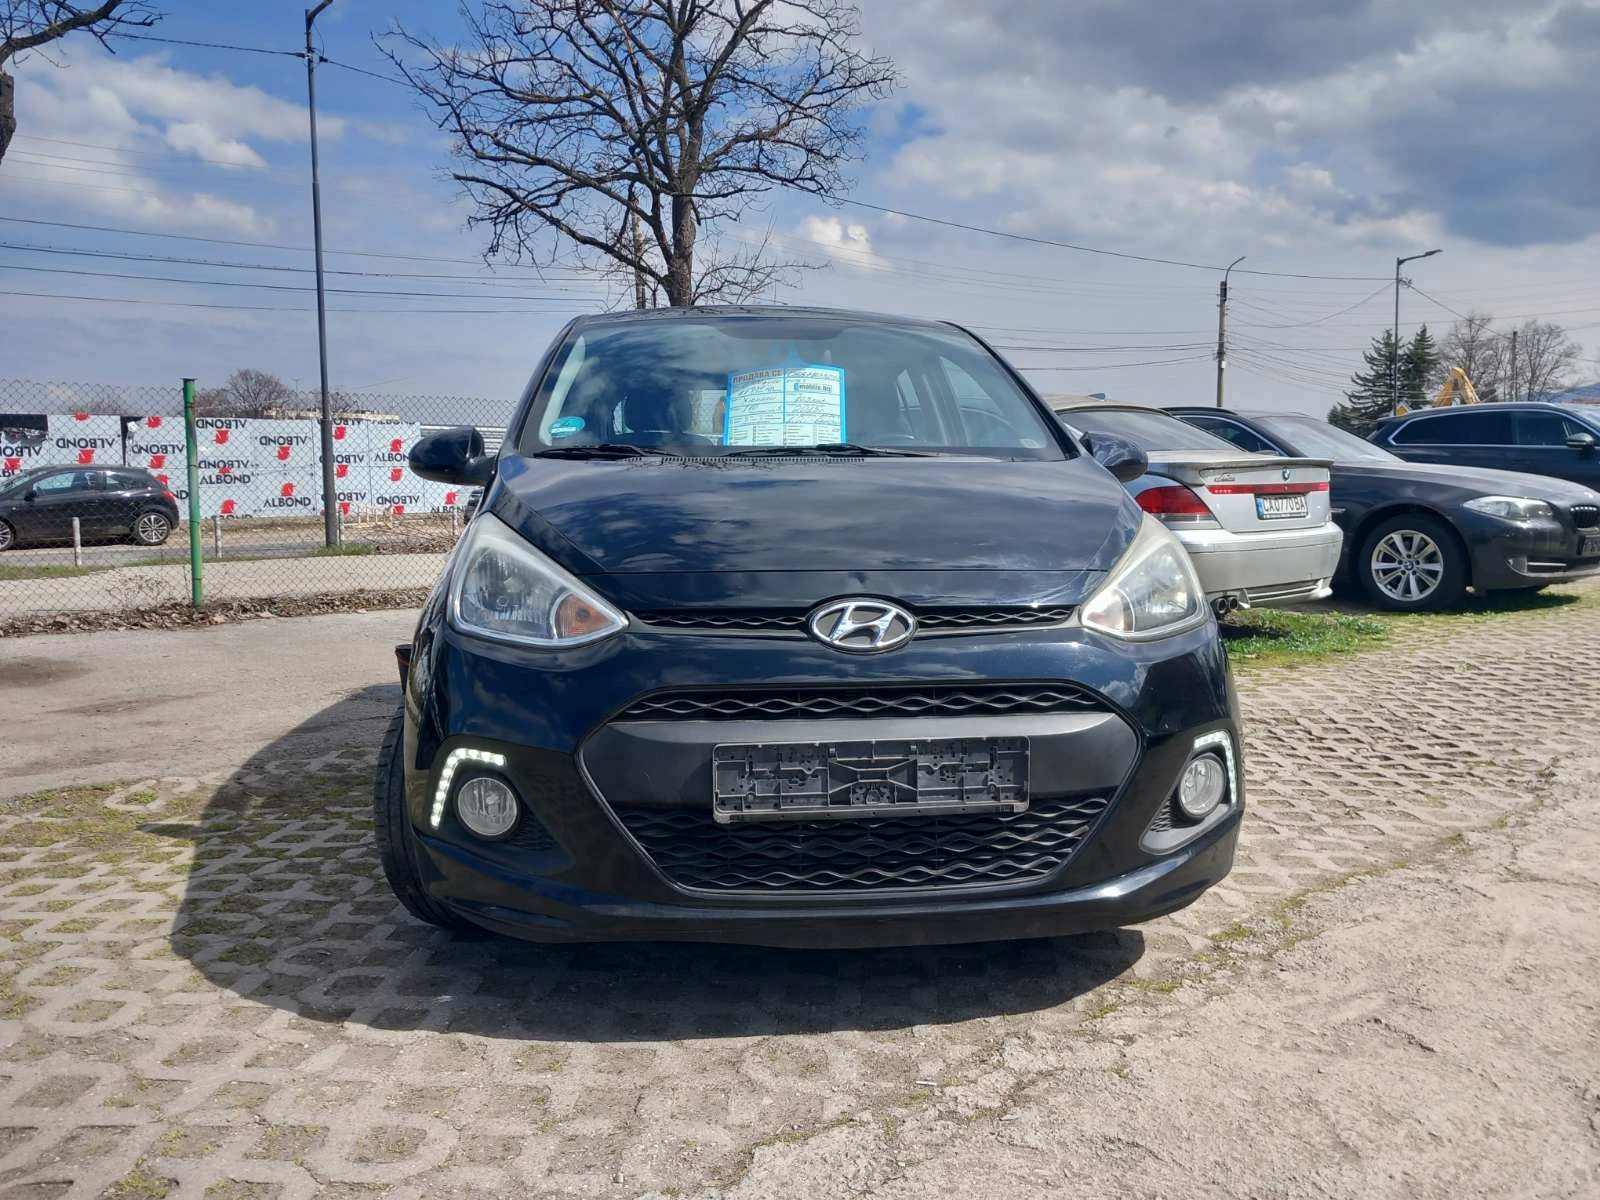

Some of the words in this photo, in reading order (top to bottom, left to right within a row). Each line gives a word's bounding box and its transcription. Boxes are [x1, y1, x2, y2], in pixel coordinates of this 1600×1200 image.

[195, 418, 247, 429] ALBOND
[55, 438, 115, 448] ALBOND
[259, 435, 308, 446] ALBOND
[132, 444, 185, 454] ALBOND
[374, 452, 410, 462] ALBON
[198, 459, 250, 469] ALBOND
[200, 474, 251, 484] ALBOND
[263, 497, 312, 508] ALBOND
[376, 495, 420, 505] ALBOND
